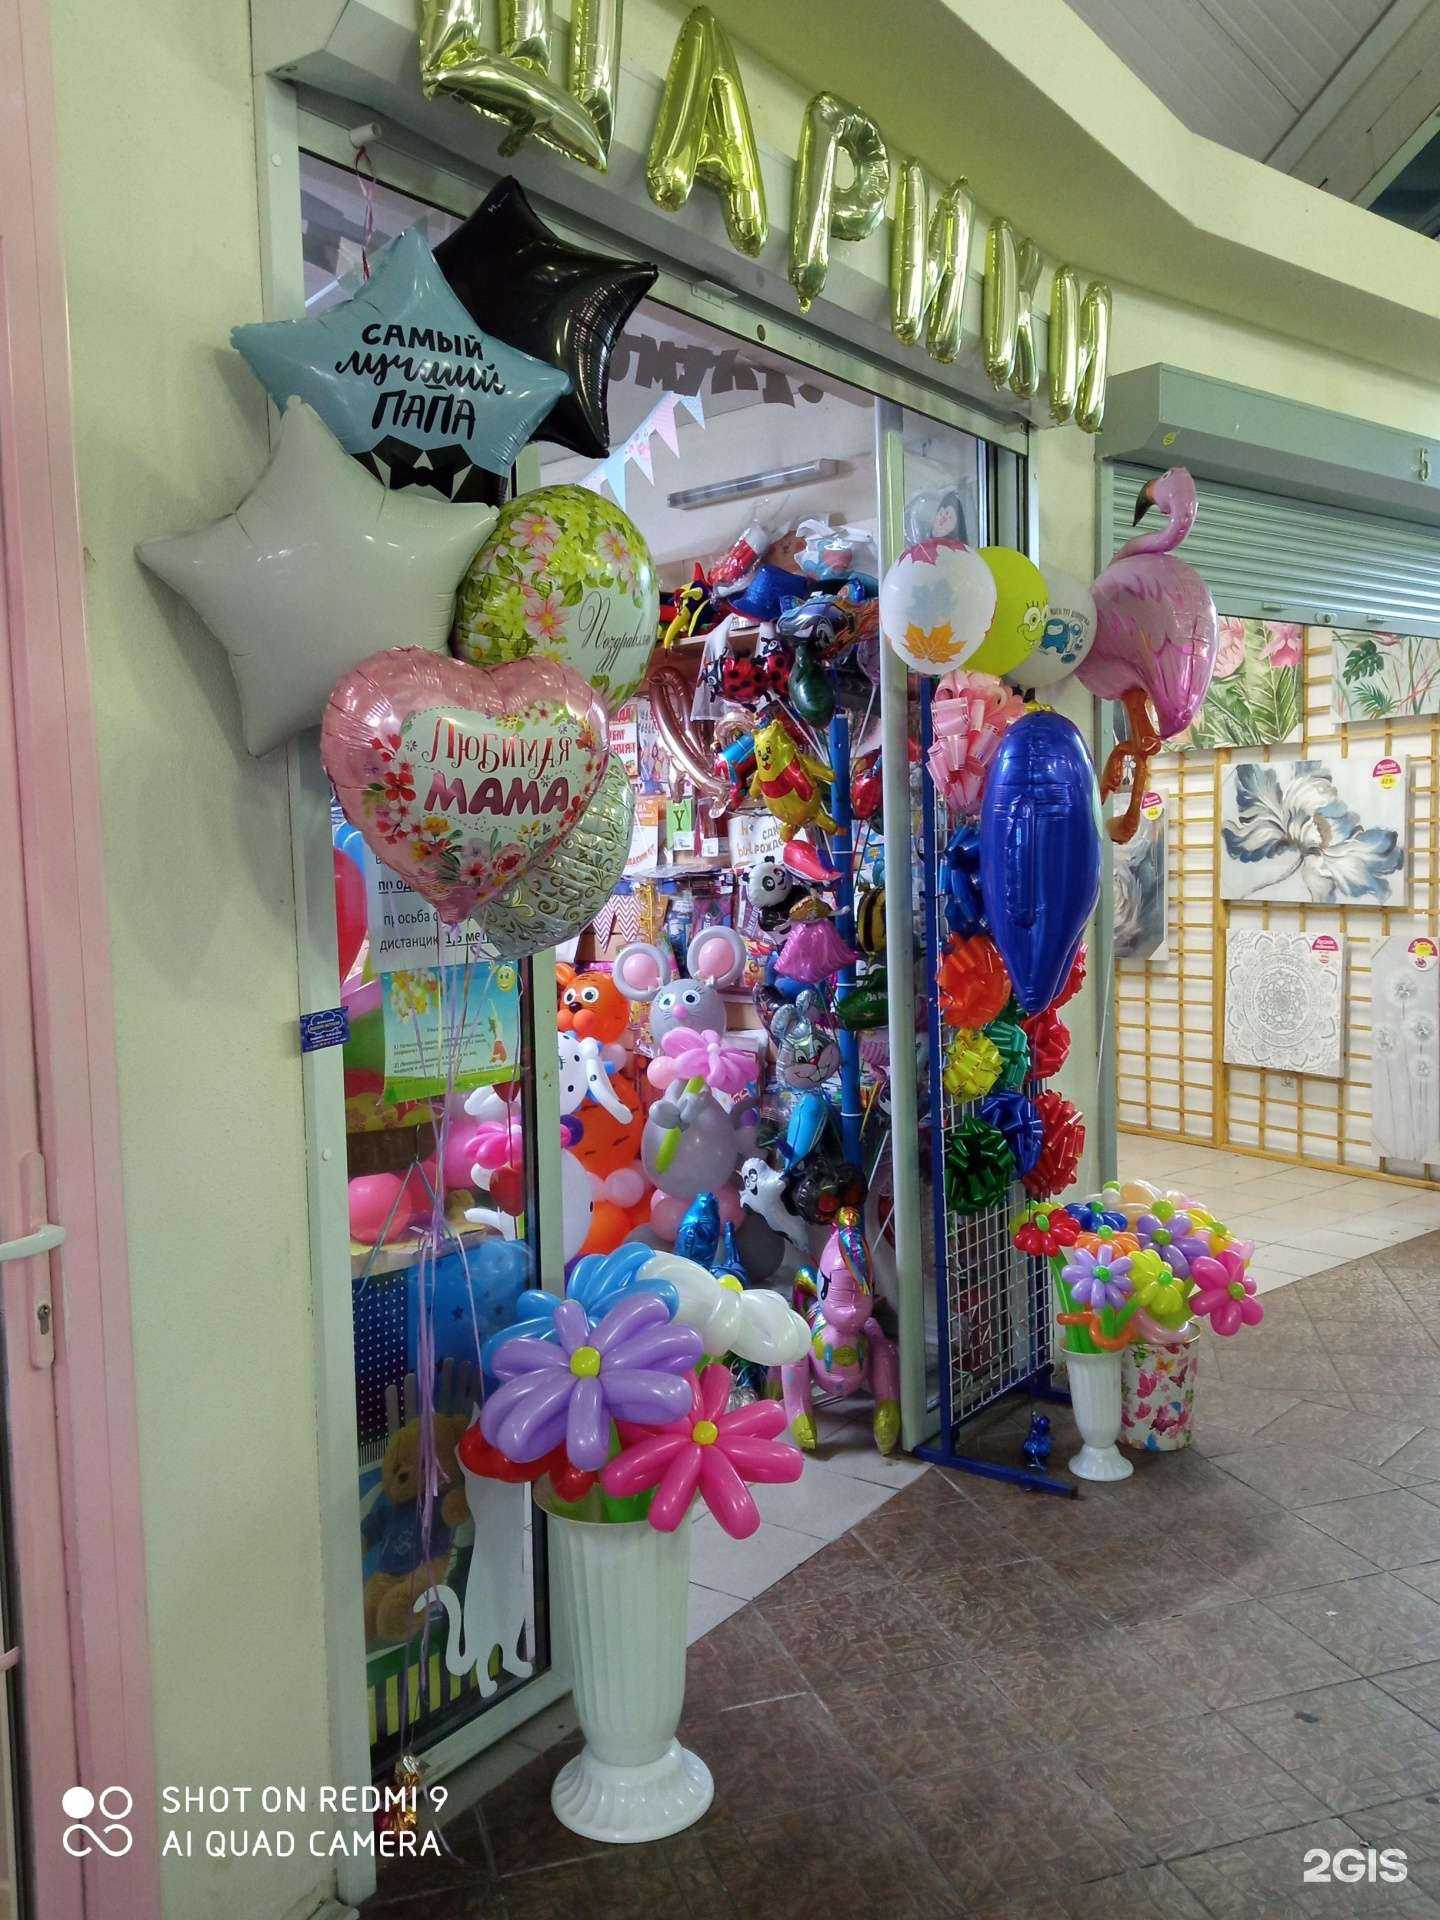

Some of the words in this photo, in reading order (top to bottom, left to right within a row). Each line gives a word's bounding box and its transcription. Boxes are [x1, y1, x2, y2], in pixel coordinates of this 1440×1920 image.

[361, 323, 484, 360] САМЫЙ
[335, 350, 506, 395] лучший
[371, 389, 476, 440] ПАПА
[424, 772, 570, 816] МАМА
